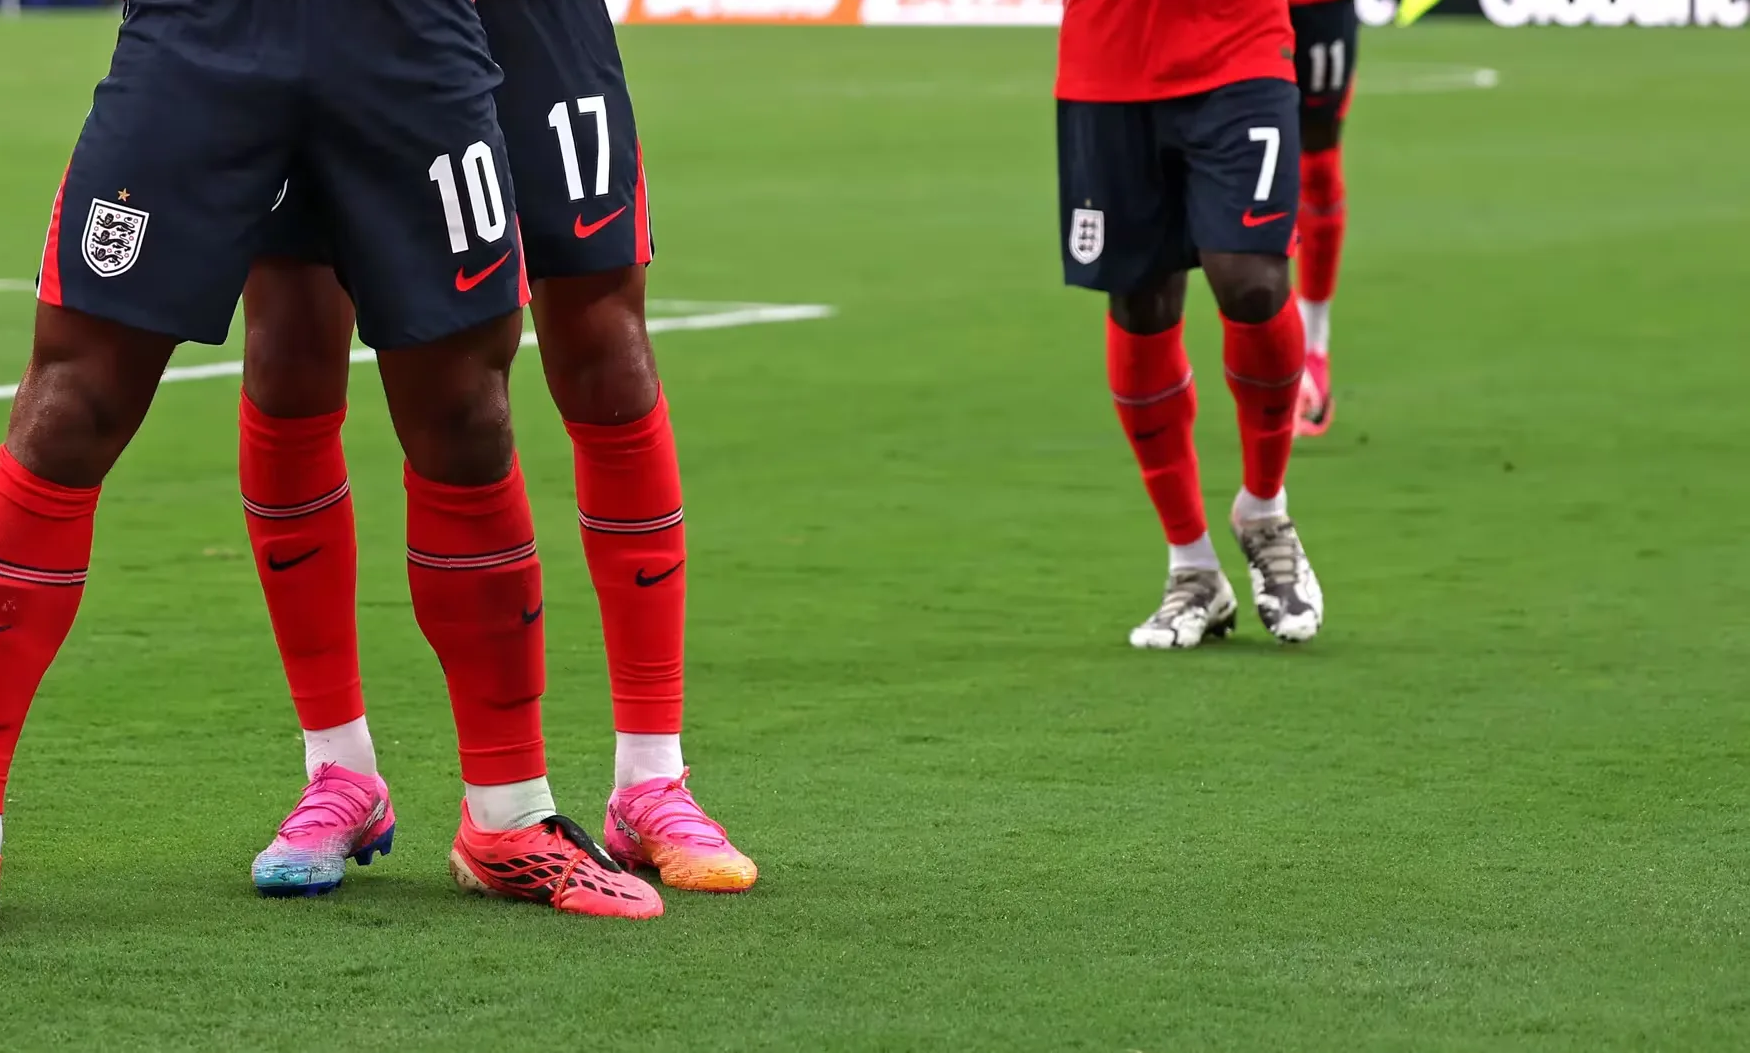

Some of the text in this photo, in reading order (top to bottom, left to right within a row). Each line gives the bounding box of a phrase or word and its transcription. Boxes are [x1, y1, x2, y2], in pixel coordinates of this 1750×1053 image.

[1310, 38, 1345, 92] 11
[548, 95, 610, 201] 17
[1248, 127, 1281, 201] 7
[428, 140, 506, 254] 10
